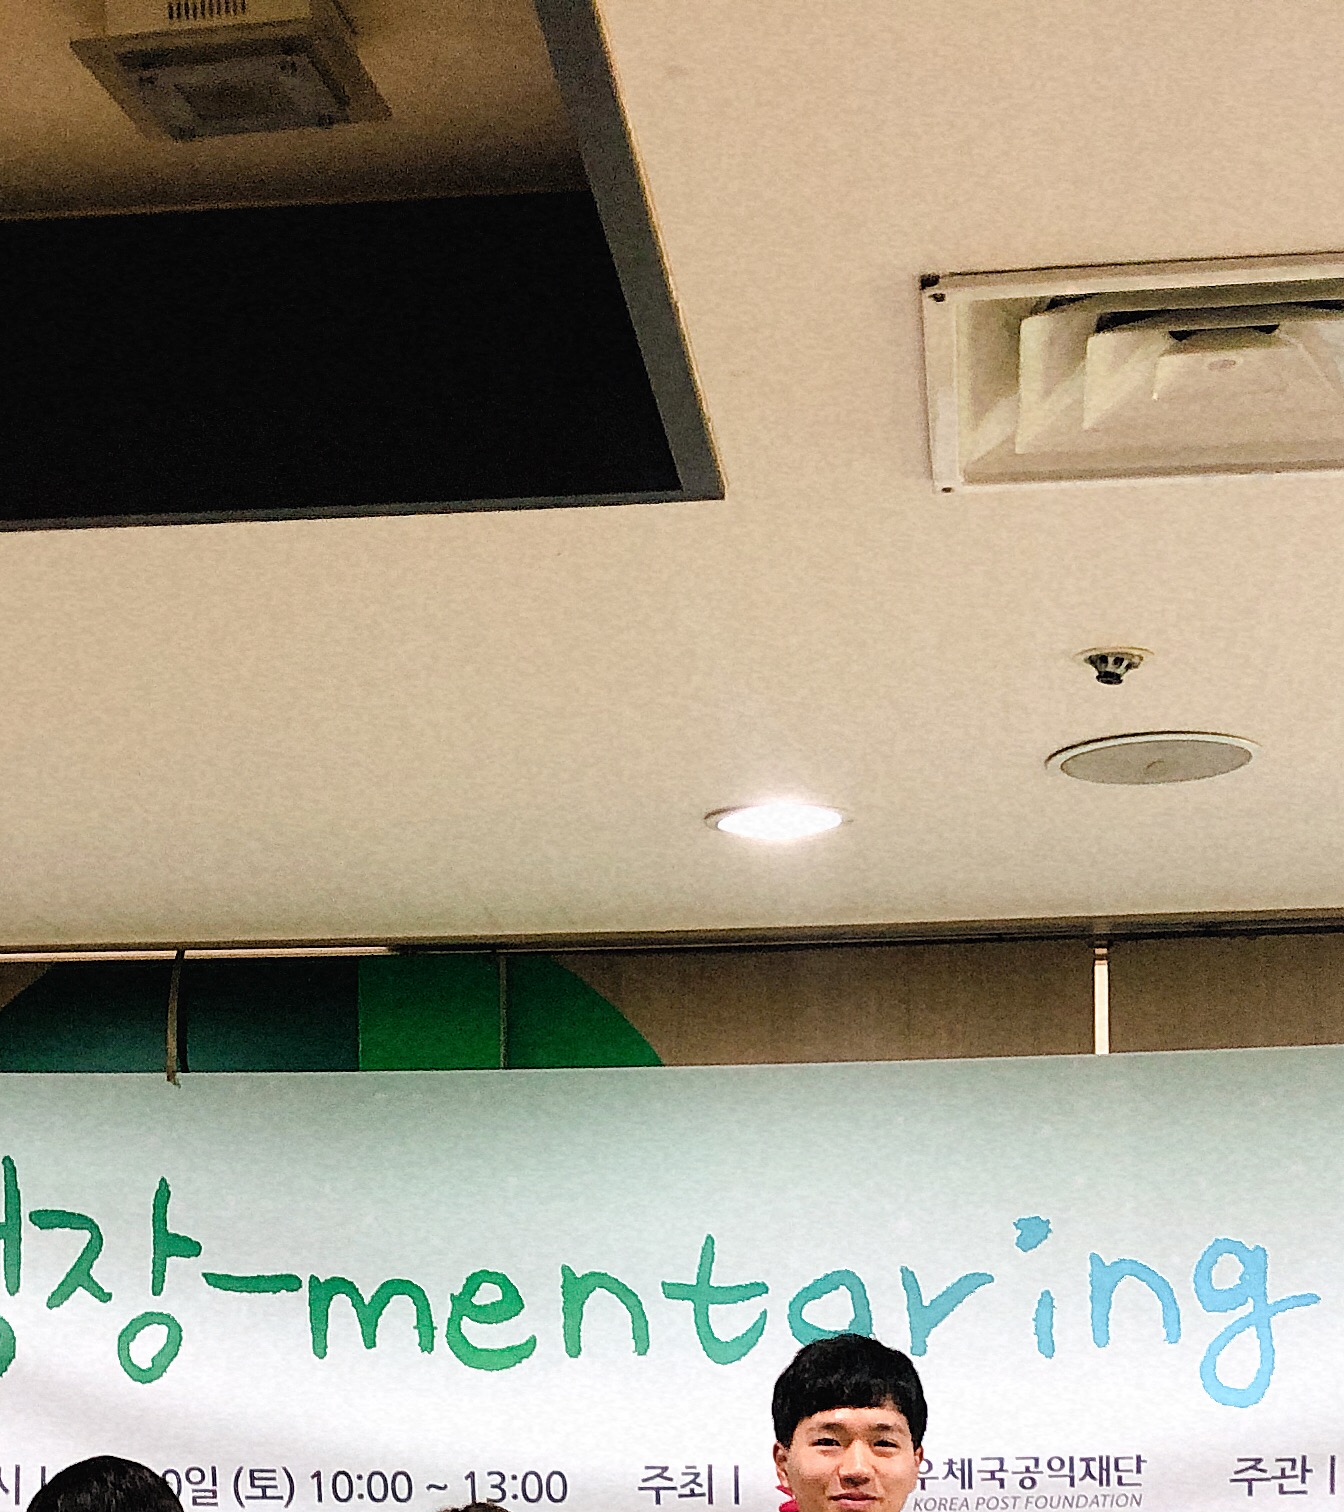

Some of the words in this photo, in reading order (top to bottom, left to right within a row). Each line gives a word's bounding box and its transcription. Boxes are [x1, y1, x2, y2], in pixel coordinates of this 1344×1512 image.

[233, 1465, 296, 1509] (토)
[309, 1469, 414, 1504] 10:00
[463, 1469, 569, 1504] 13:00
[636, 1463, 715, 1507] 주최
[917, 1453, 1148, 1492] 우체국공익재단
[1228, 1453, 1314, 1498] 주관
[912, 1497, 970, 1512] KOREA
[974, 1495, 1022, 1512] POST
[1023, 1493, 1144, 1511] FOUNDATION
